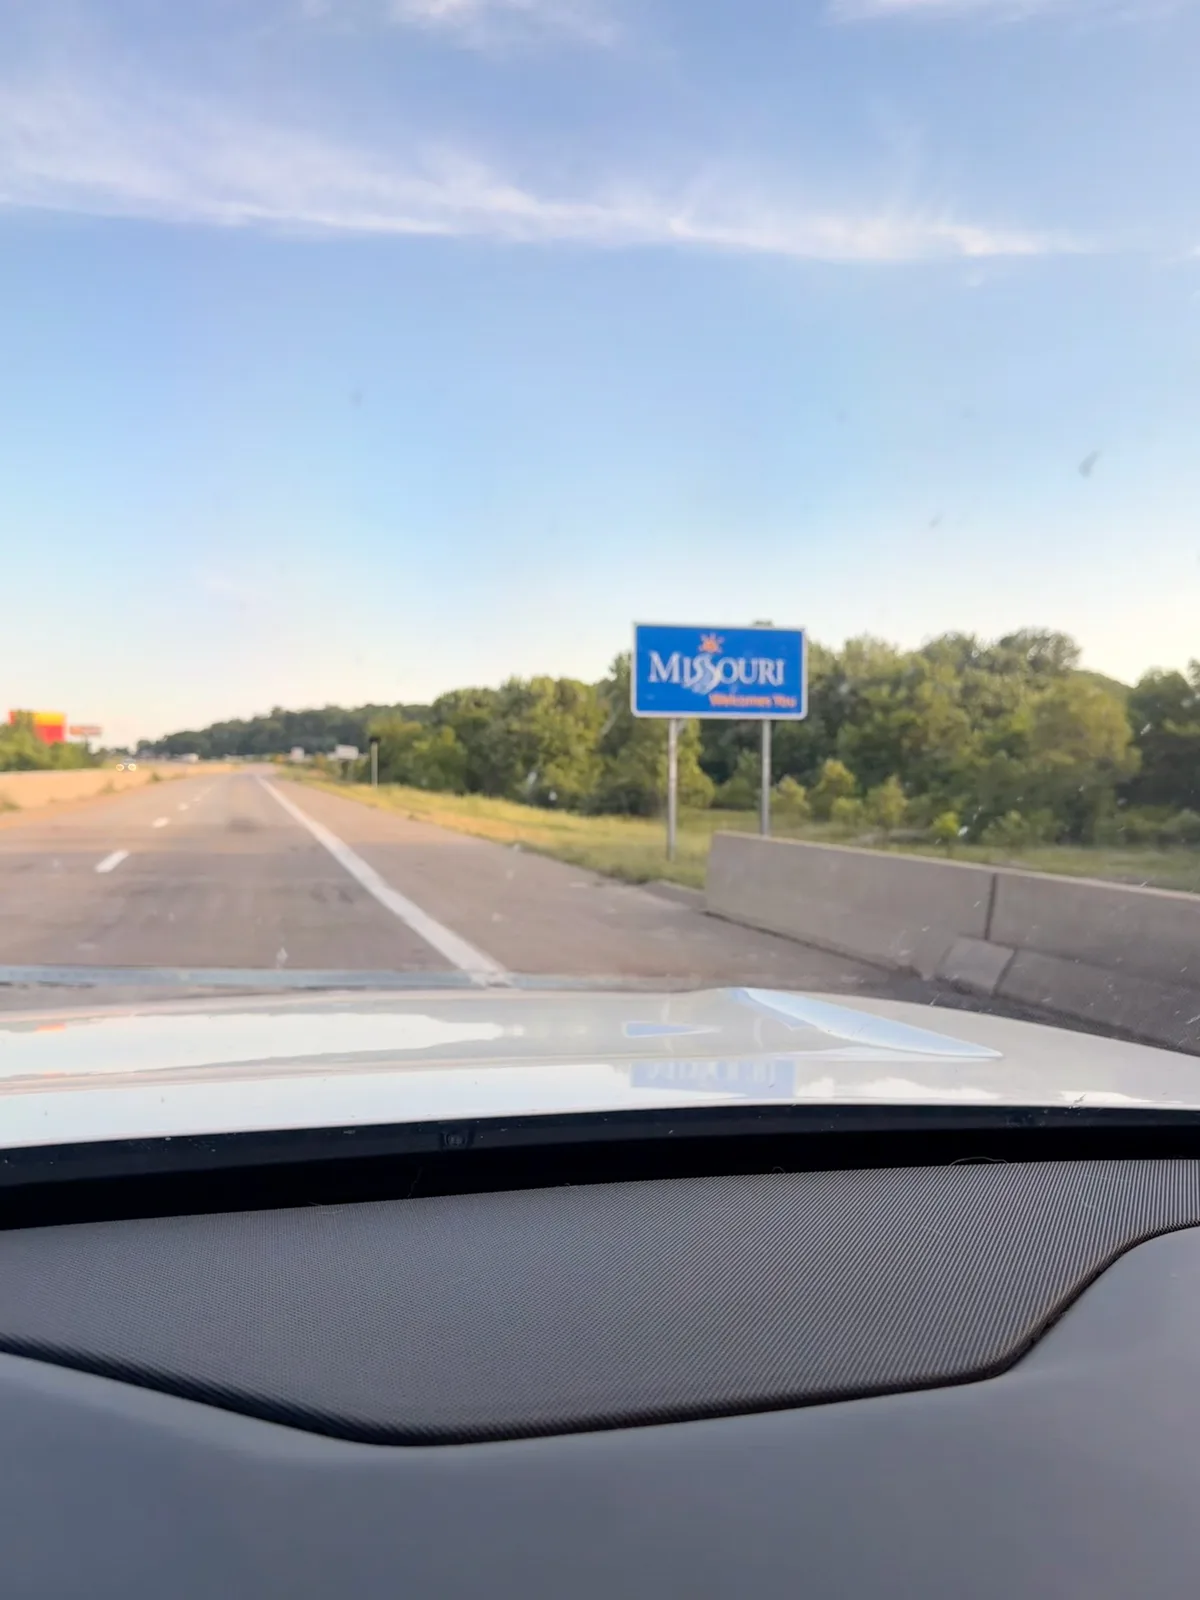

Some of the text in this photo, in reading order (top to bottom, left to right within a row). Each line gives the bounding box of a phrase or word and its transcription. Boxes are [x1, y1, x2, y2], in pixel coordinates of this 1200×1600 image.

[648, 650, 784, 694] MISSOURI
[709, 693, 797, 708] Welcomes You
